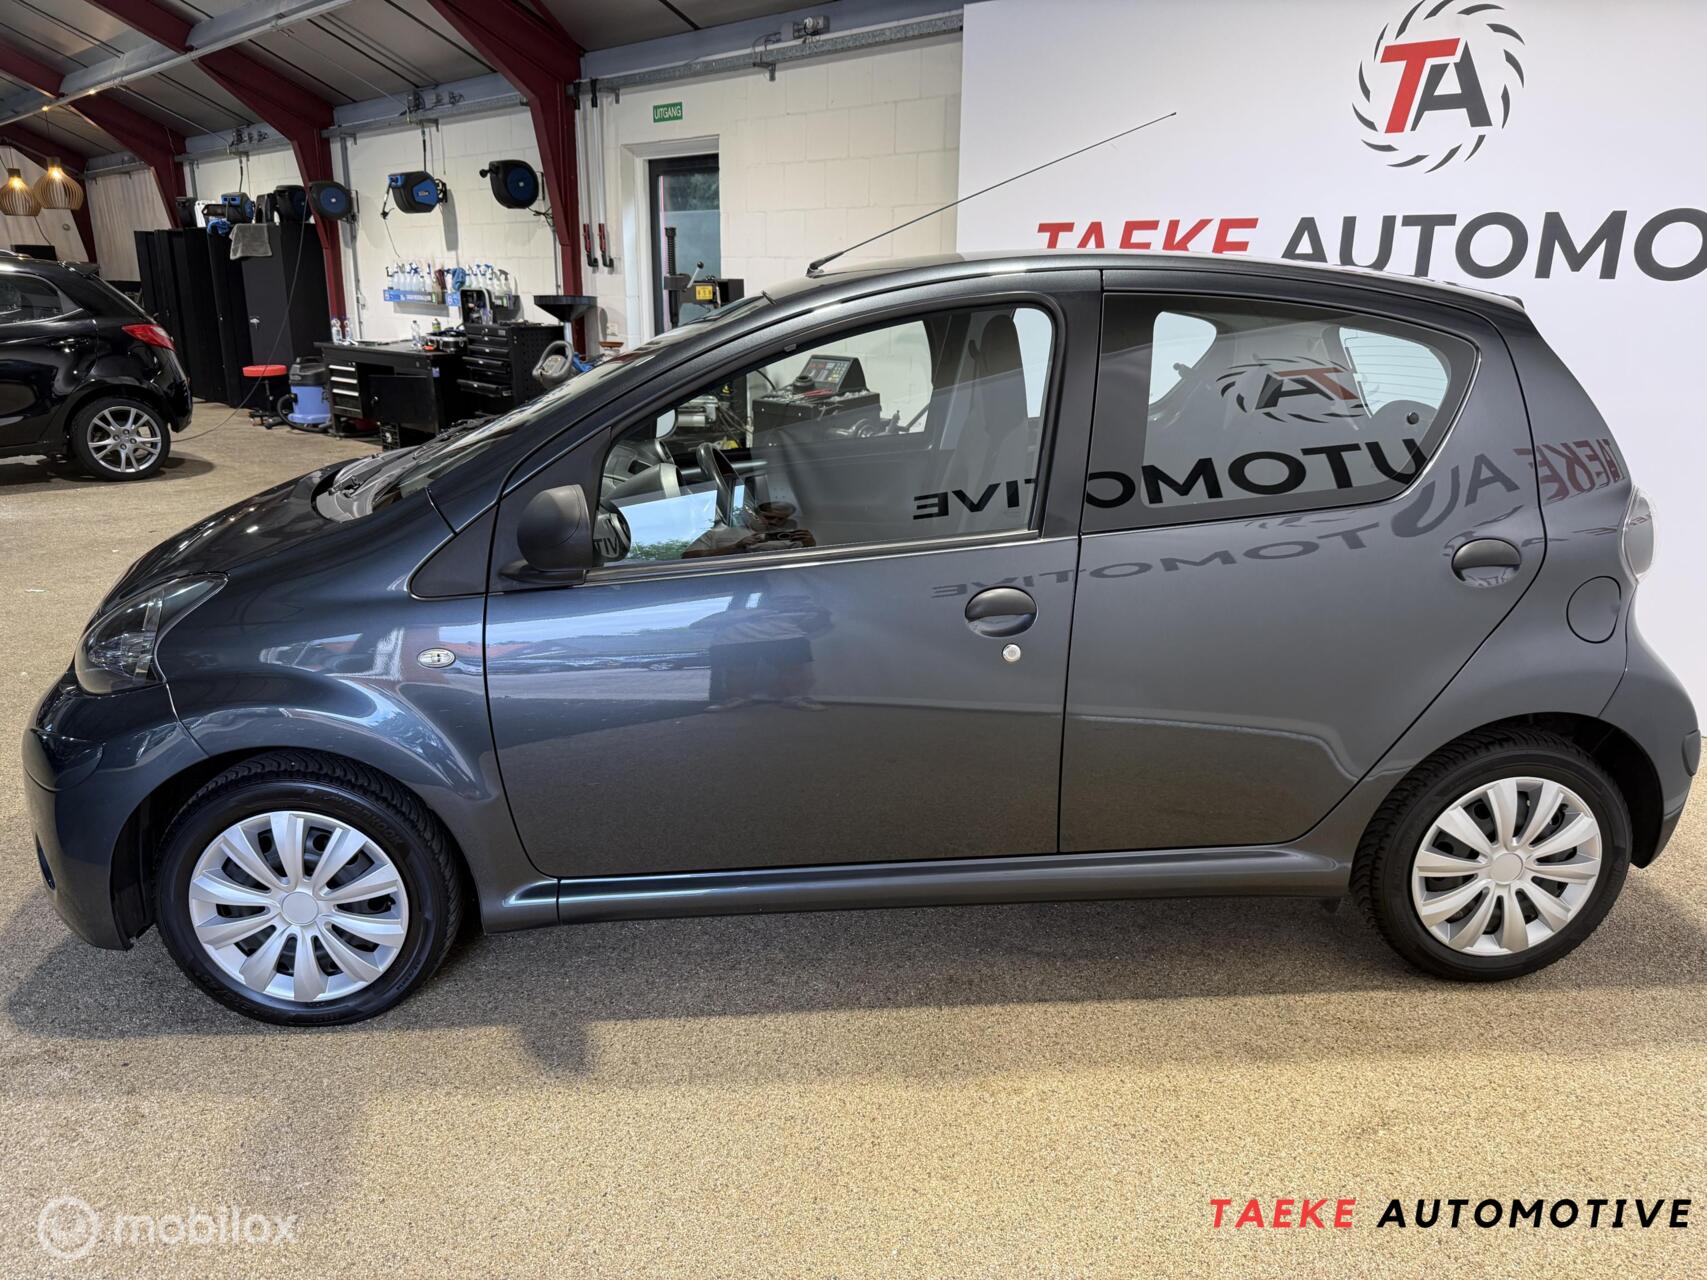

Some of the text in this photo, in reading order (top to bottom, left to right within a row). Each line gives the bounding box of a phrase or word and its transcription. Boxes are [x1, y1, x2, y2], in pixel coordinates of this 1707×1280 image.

[654, 105, 682, 120] UITGANG
[1380, 38, 1493, 134] TA
[1281, 207, 1707, 282] AUTOMO
